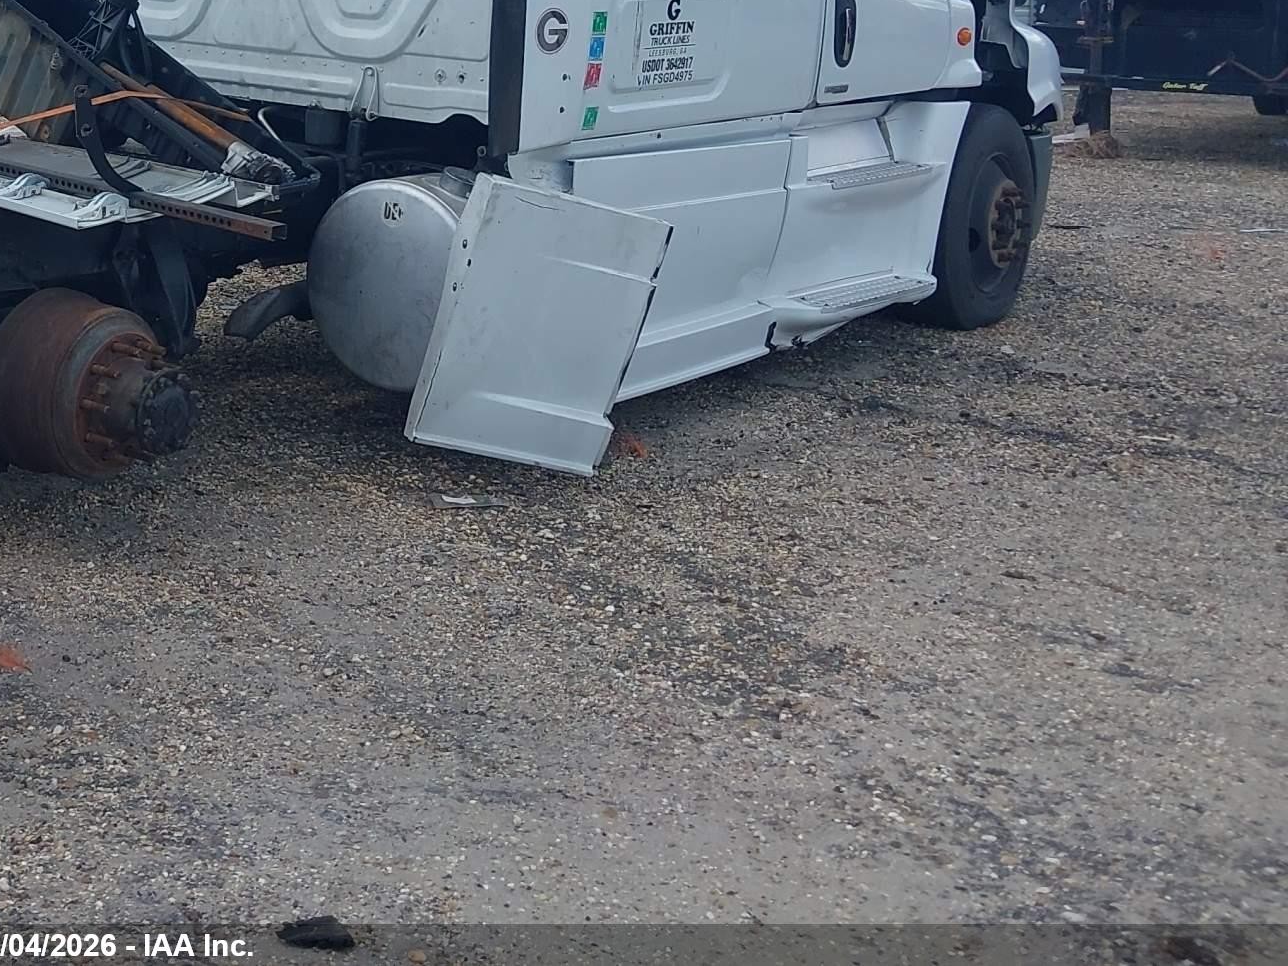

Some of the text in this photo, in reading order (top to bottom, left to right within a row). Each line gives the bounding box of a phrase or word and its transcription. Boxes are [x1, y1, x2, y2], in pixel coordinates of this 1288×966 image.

[536, 9, 569, 52] G
[649, 21, 695, 36] GRIFFIN
[642, 56, 694, 73] USDOT 3642917
[637, 70, 693, 86] VIN FSGD4975
